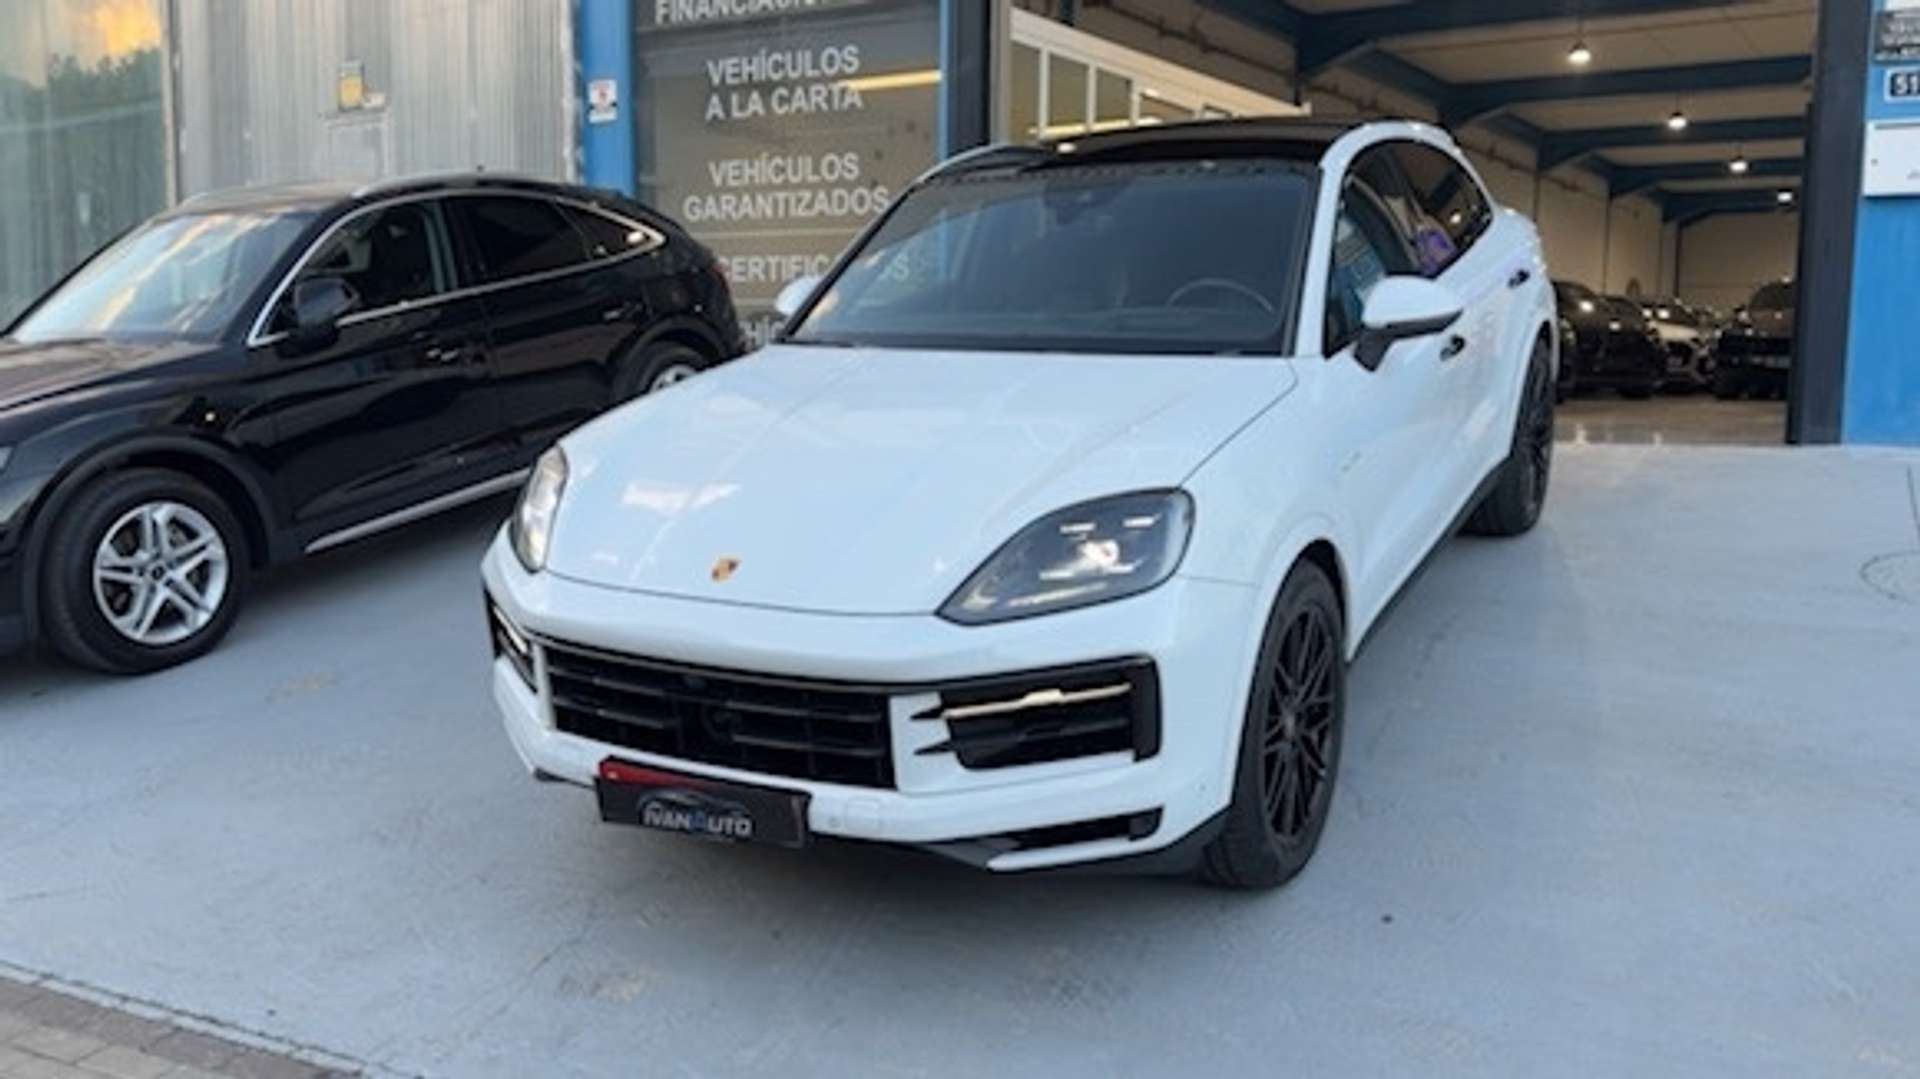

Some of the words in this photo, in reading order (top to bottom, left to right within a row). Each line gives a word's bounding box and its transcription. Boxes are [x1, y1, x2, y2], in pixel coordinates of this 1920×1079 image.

[707, 46, 860, 85] VEHÍCULOS
[705, 94, 726, 120] A
[731, 91, 764, 118] LA
[771, 81, 863, 115] CARTA
[709, 152, 859, 187] VEHÍCULOS
[684, 186, 889, 221] GARANTIZADOS
